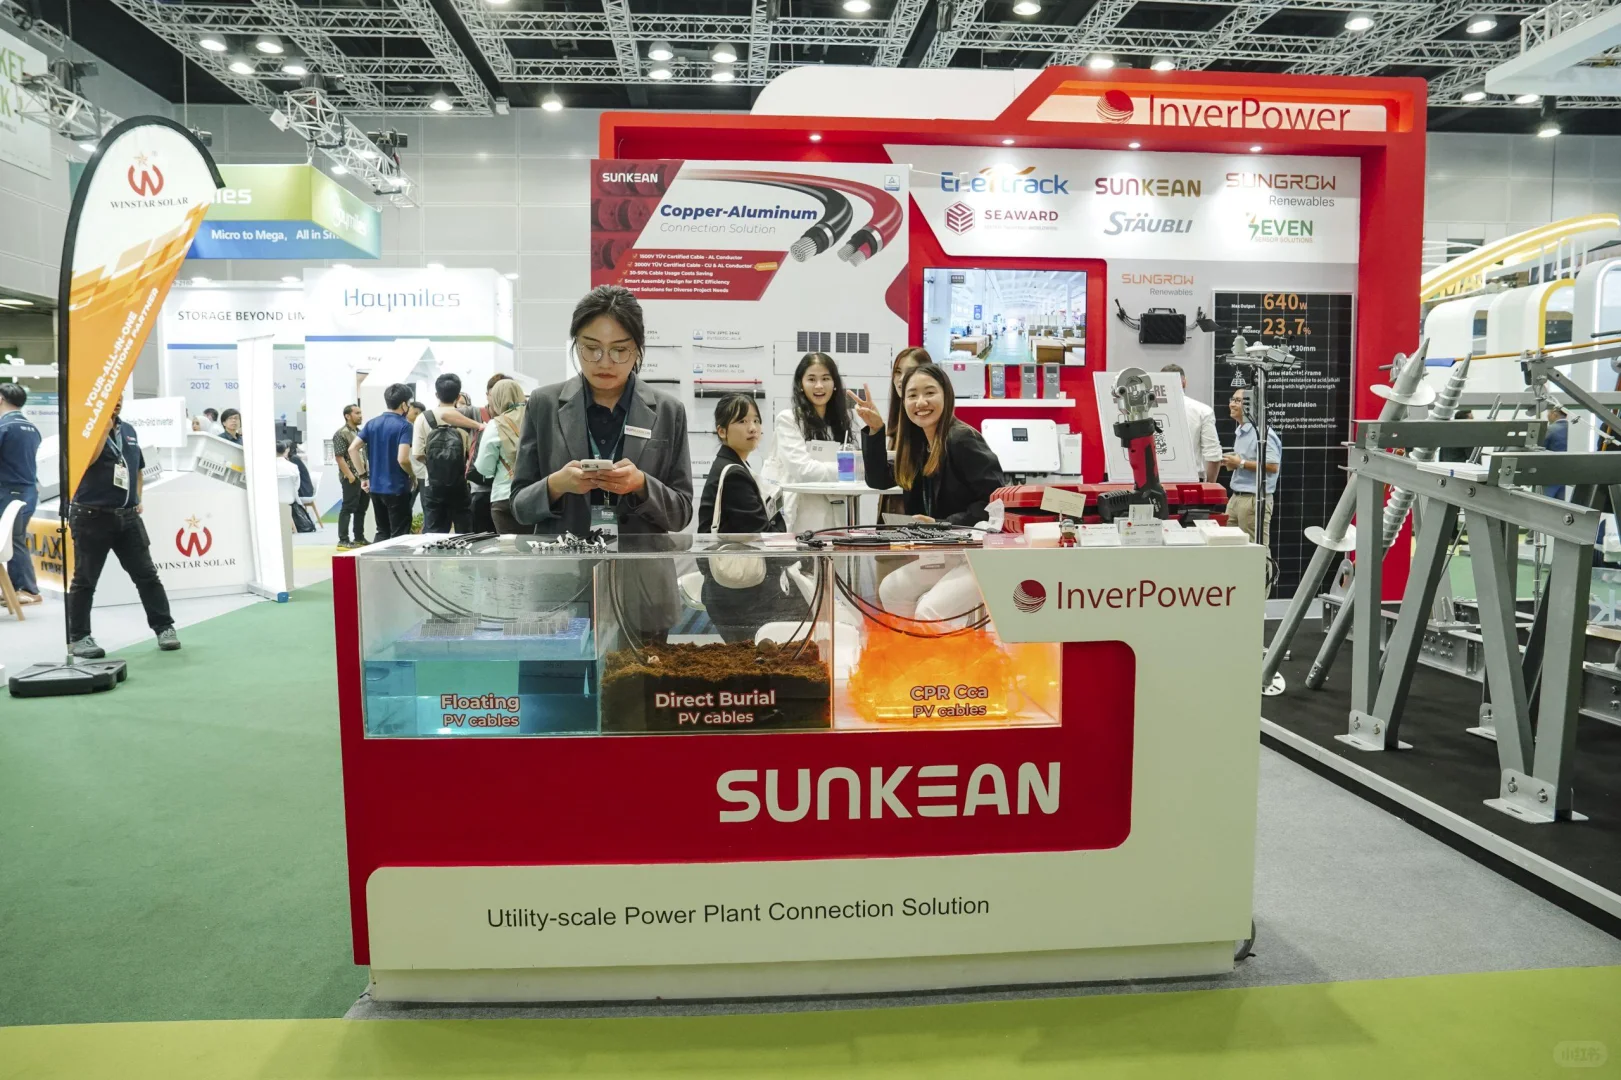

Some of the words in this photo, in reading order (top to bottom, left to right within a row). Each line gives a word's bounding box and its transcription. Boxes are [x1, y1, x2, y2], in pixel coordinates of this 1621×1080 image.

[1150, 94, 1351, 131] InverPower
[602, 172, 659, 184] SUNKEAN
[1226, 172, 1336, 190] SUNGROW
[1095, 177, 1201, 197] SUNKEAN
[110, 200, 155, 209] WINSTAR
[157, 196, 189, 207] SOLAR
[1269, 195, 1335, 207] Renewables
[660, 204, 818, 220] Copper-Aluminum
[984, 210, 1059, 221] SEAWARD
[660, 222, 726, 234] Connection
[729, 223, 776, 235] Solution
[1103, 211, 1193, 236] STÄUBLI
[211, 229, 240, 240] Micro
[242, 229, 254, 240] to
[255, 229, 288, 243] Mega,
[296, 229, 310, 239] All
[311, 230, 321, 240] in
[1121, 273, 1194, 285] SUNGROW
[1149, 288, 1193, 296] Renewables
[344, 288, 461, 313] Hoymiles
[178, 311, 232, 321] STORAGE
[235, 311, 284, 321] BEYOND
[81, 400, 106, 439] SOLAR
[101, 337, 134, 400] SOLUTIONS
[131, 287, 160, 339] PARTNER
[198, 362, 215, 370] Tier
[216, 362, 220, 370] 1
[190, 381, 210, 390] 2012
[154, 561, 201, 571] WINSTAR
[203, 557, 236, 568] SOLAR
[1057, 579, 1237, 609] InverPower
[910, 685, 950, 700] CPR
[954, 684, 989, 699] Cca
[440, 693, 520, 712] Floating
[655, 692, 714, 709] Direct
[719, 690, 775, 707] Burial
[912, 704, 936, 718] PV
[937, 703, 987, 717] cables
[443, 714, 466, 727] PV
[468, 714, 520, 727] cables
[678, 712, 700, 725] PV
[703, 711, 754, 725] cables
[715, 761, 1061, 823] SUNKEAN
[487, 906, 617, 932] Utility-scale
[625, 903, 697, 925] Power
[703, 902, 762, 923] Plant
[768, 898, 895, 922] Connection
[902, 896, 990, 917] Solution
